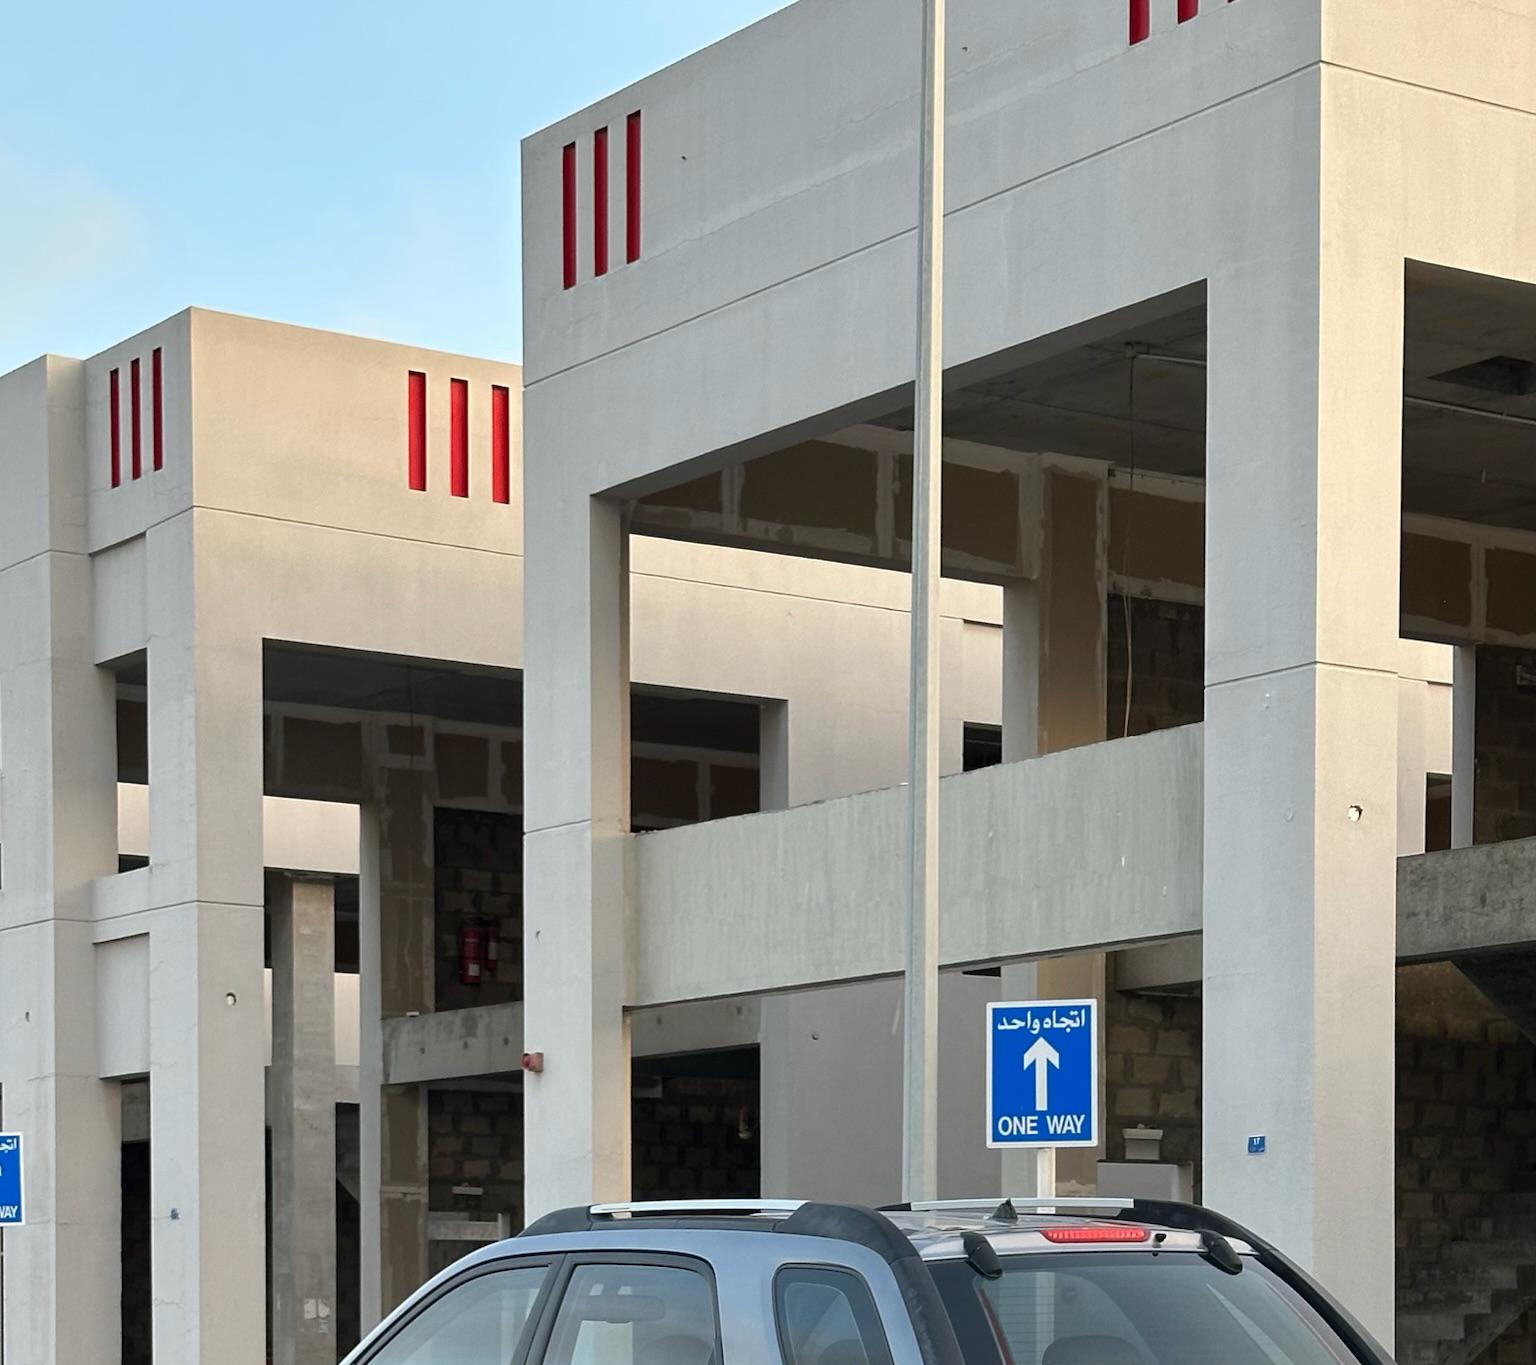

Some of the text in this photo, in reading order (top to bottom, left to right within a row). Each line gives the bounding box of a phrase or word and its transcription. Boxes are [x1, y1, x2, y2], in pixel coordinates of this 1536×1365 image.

[997, 1008, 1085, 1035] اتجاه واحد
[997, 1114, 1085, 1136] ONE WAY
[0, 1137, 17, 1154] اتج
